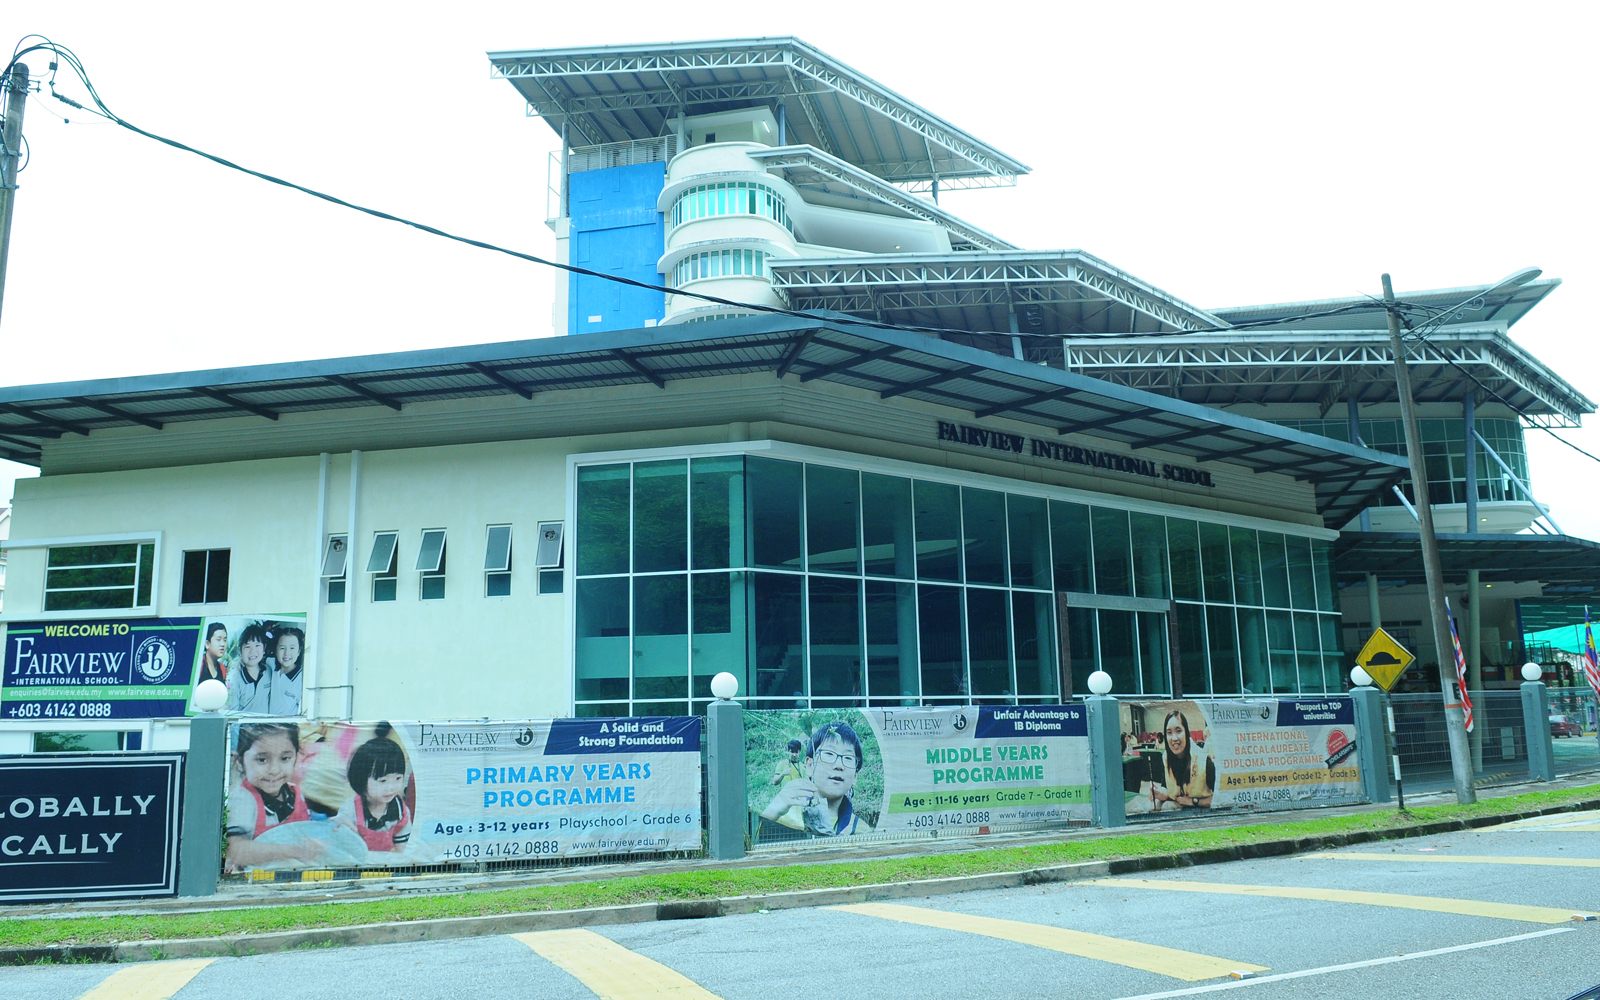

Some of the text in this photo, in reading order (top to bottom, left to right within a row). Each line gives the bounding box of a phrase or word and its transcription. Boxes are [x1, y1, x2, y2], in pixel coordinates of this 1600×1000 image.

[937, 421, 1216, 488] FAIRVIEW INTERNATIONAL SCHOOL
[45, 623, 129, 637] WELCOME TO
[11, 637, 126, 675] FAIRVIEW
[9, 687, 184, 699] enquiries@fairview.edu.my www.fairview.edu.my
[9, 702, 112, 717] +603 4142 0888
[1211, 703, 1252, 720] FAIRVIEW
[1295, 702, 1342, 711] Passport to TOP
[883, 711, 942, 730] FAIRVIEW
[993, 709, 1080, 722] Unfair Advantage to
[1303, 711, 1337, 720] universities
[600, 721, 664, 733] A Solid and
[1014, 720, 1062, 732] IB Diploma
[418, 723, 501, 747] FAIRVIEW
[578, 734, 684, 748] Strong Foundation
[1235, 731, 1308, 742] INTERNATIONAL
[926, 744, 1049, 765] MIDDLE YEARS
[1234, 743, 1310, 755] BACCALAUREATE
[1223, 755, 1325, 769] DIPLOMA PROGRAMME
[466, 761, 651, 785] PRIMARY YEARS
[933, 765, 1044, 785] PROGRAMME
[1226, 776, 1241, 786] Age
[1248, 775, 1267, 784] 16-19
[1268, 774, 1288, 784] years
[1292, 771, 1314, 781] Grade
[483, 785, 636, 808] PROGRAMME
[903, 797, 925, 809] Age
[935, 794, 959, 806] 11-16
[962, 793, 990, 807] years
[996, 791, 1026, 802] Grade
[1028, 790, 1034, 800] 7
[1044, 788, 1073, 800] Grade
[1074, 789, 1082, 799] 11
[1233, 791, 1251, 802] +603
[1253, 790, 1271, 801] 4142
[1273, 788, 1290, 800] 0888
[434, 822, 463, 836] Age
[478, 821, 507, 833] 3-12
[511, 820, 550, 834] years
[559, 815, 628, 831] Playschool
[642, 813, 680, 826] Grade
[684, 813, 692, 825] 6
[907, 808, 1072, 828] +603 4142 0888 www.fairview.edu.my
[443, 837, 670, 858] +603 4142 0888 www.fairview.edu.my
